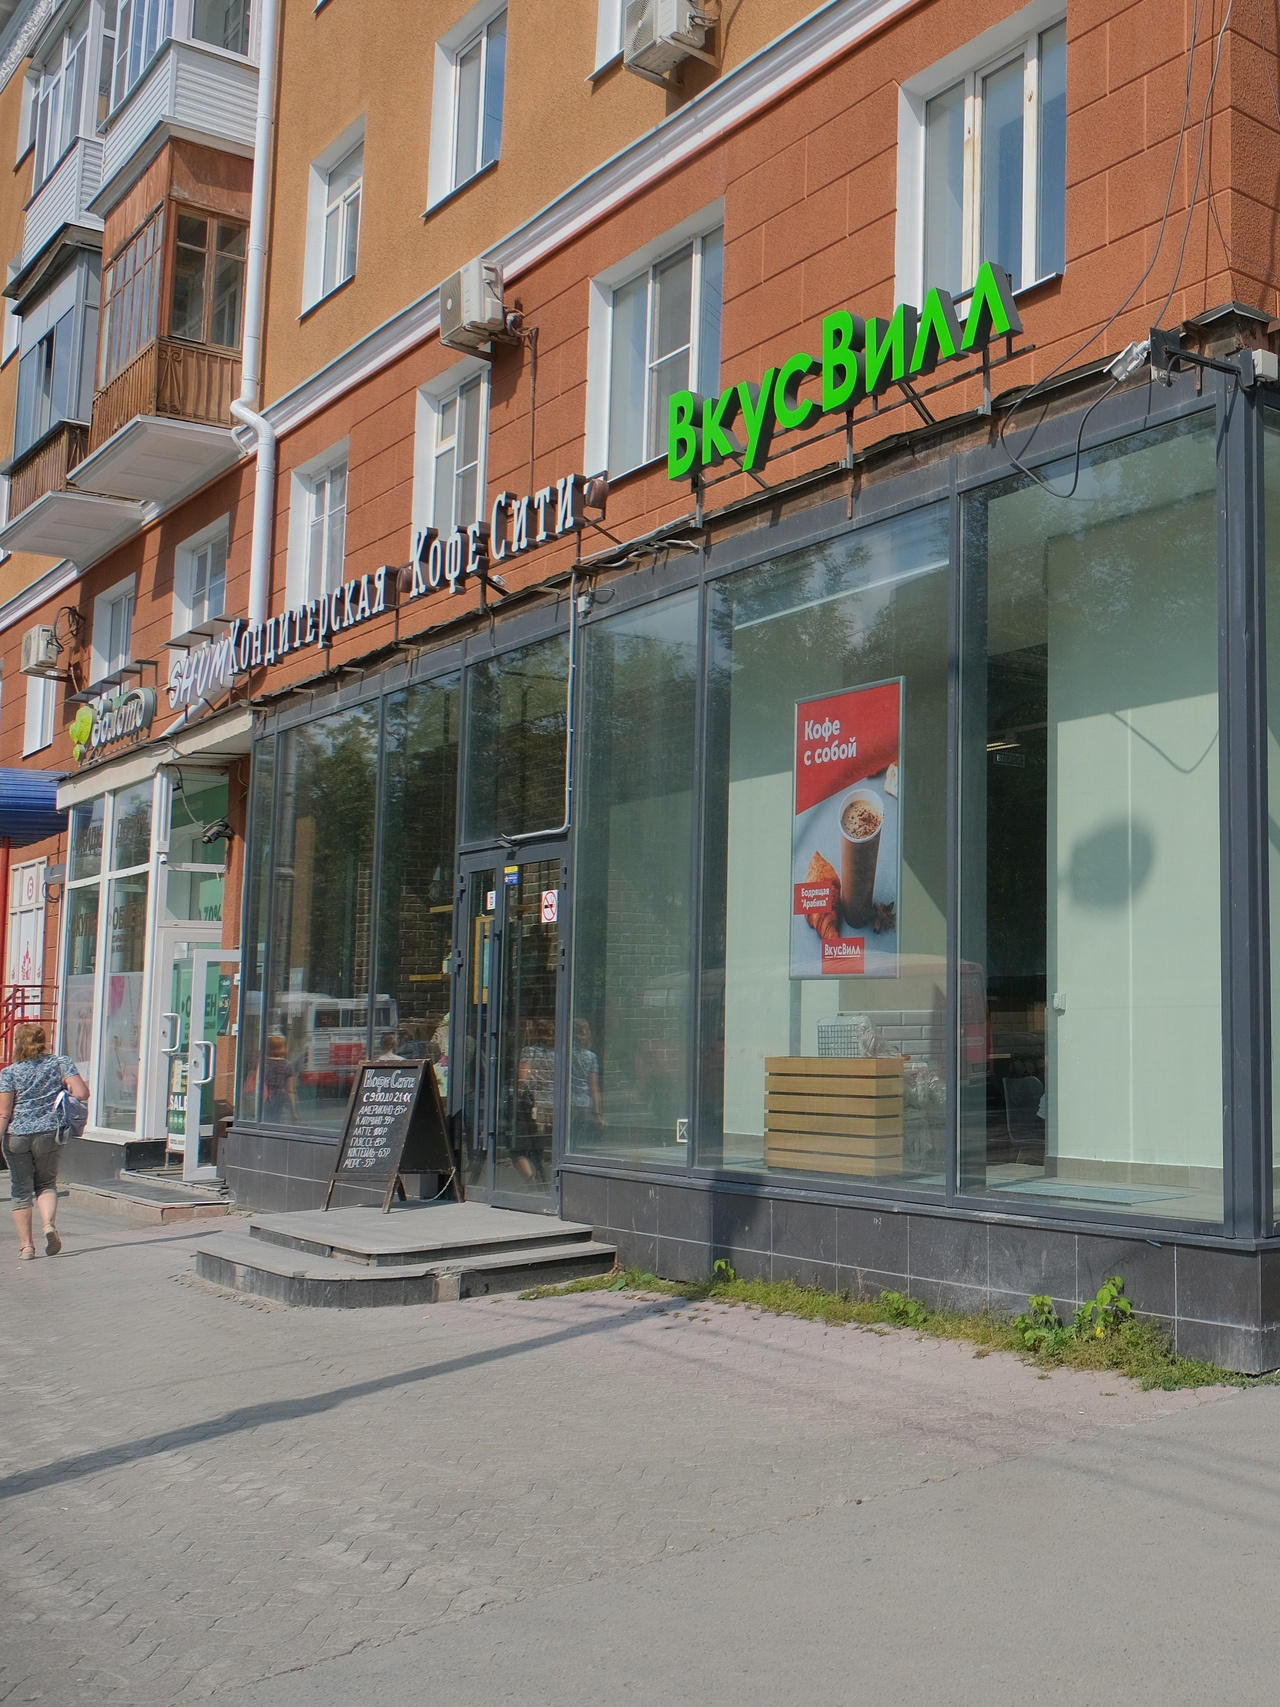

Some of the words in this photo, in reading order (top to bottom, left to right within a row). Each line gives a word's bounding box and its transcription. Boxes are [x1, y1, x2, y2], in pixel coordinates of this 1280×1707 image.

[667, 261, 1016, 482] ВкусВилл
[804, 718, 841, 742] Кофе
[803, 750, 812, 766] с
[814, 737, 857, 764] собой
[801, 888, 830, 898] Бодрящая
[824, 943, 861, 957] ВкусВилл
